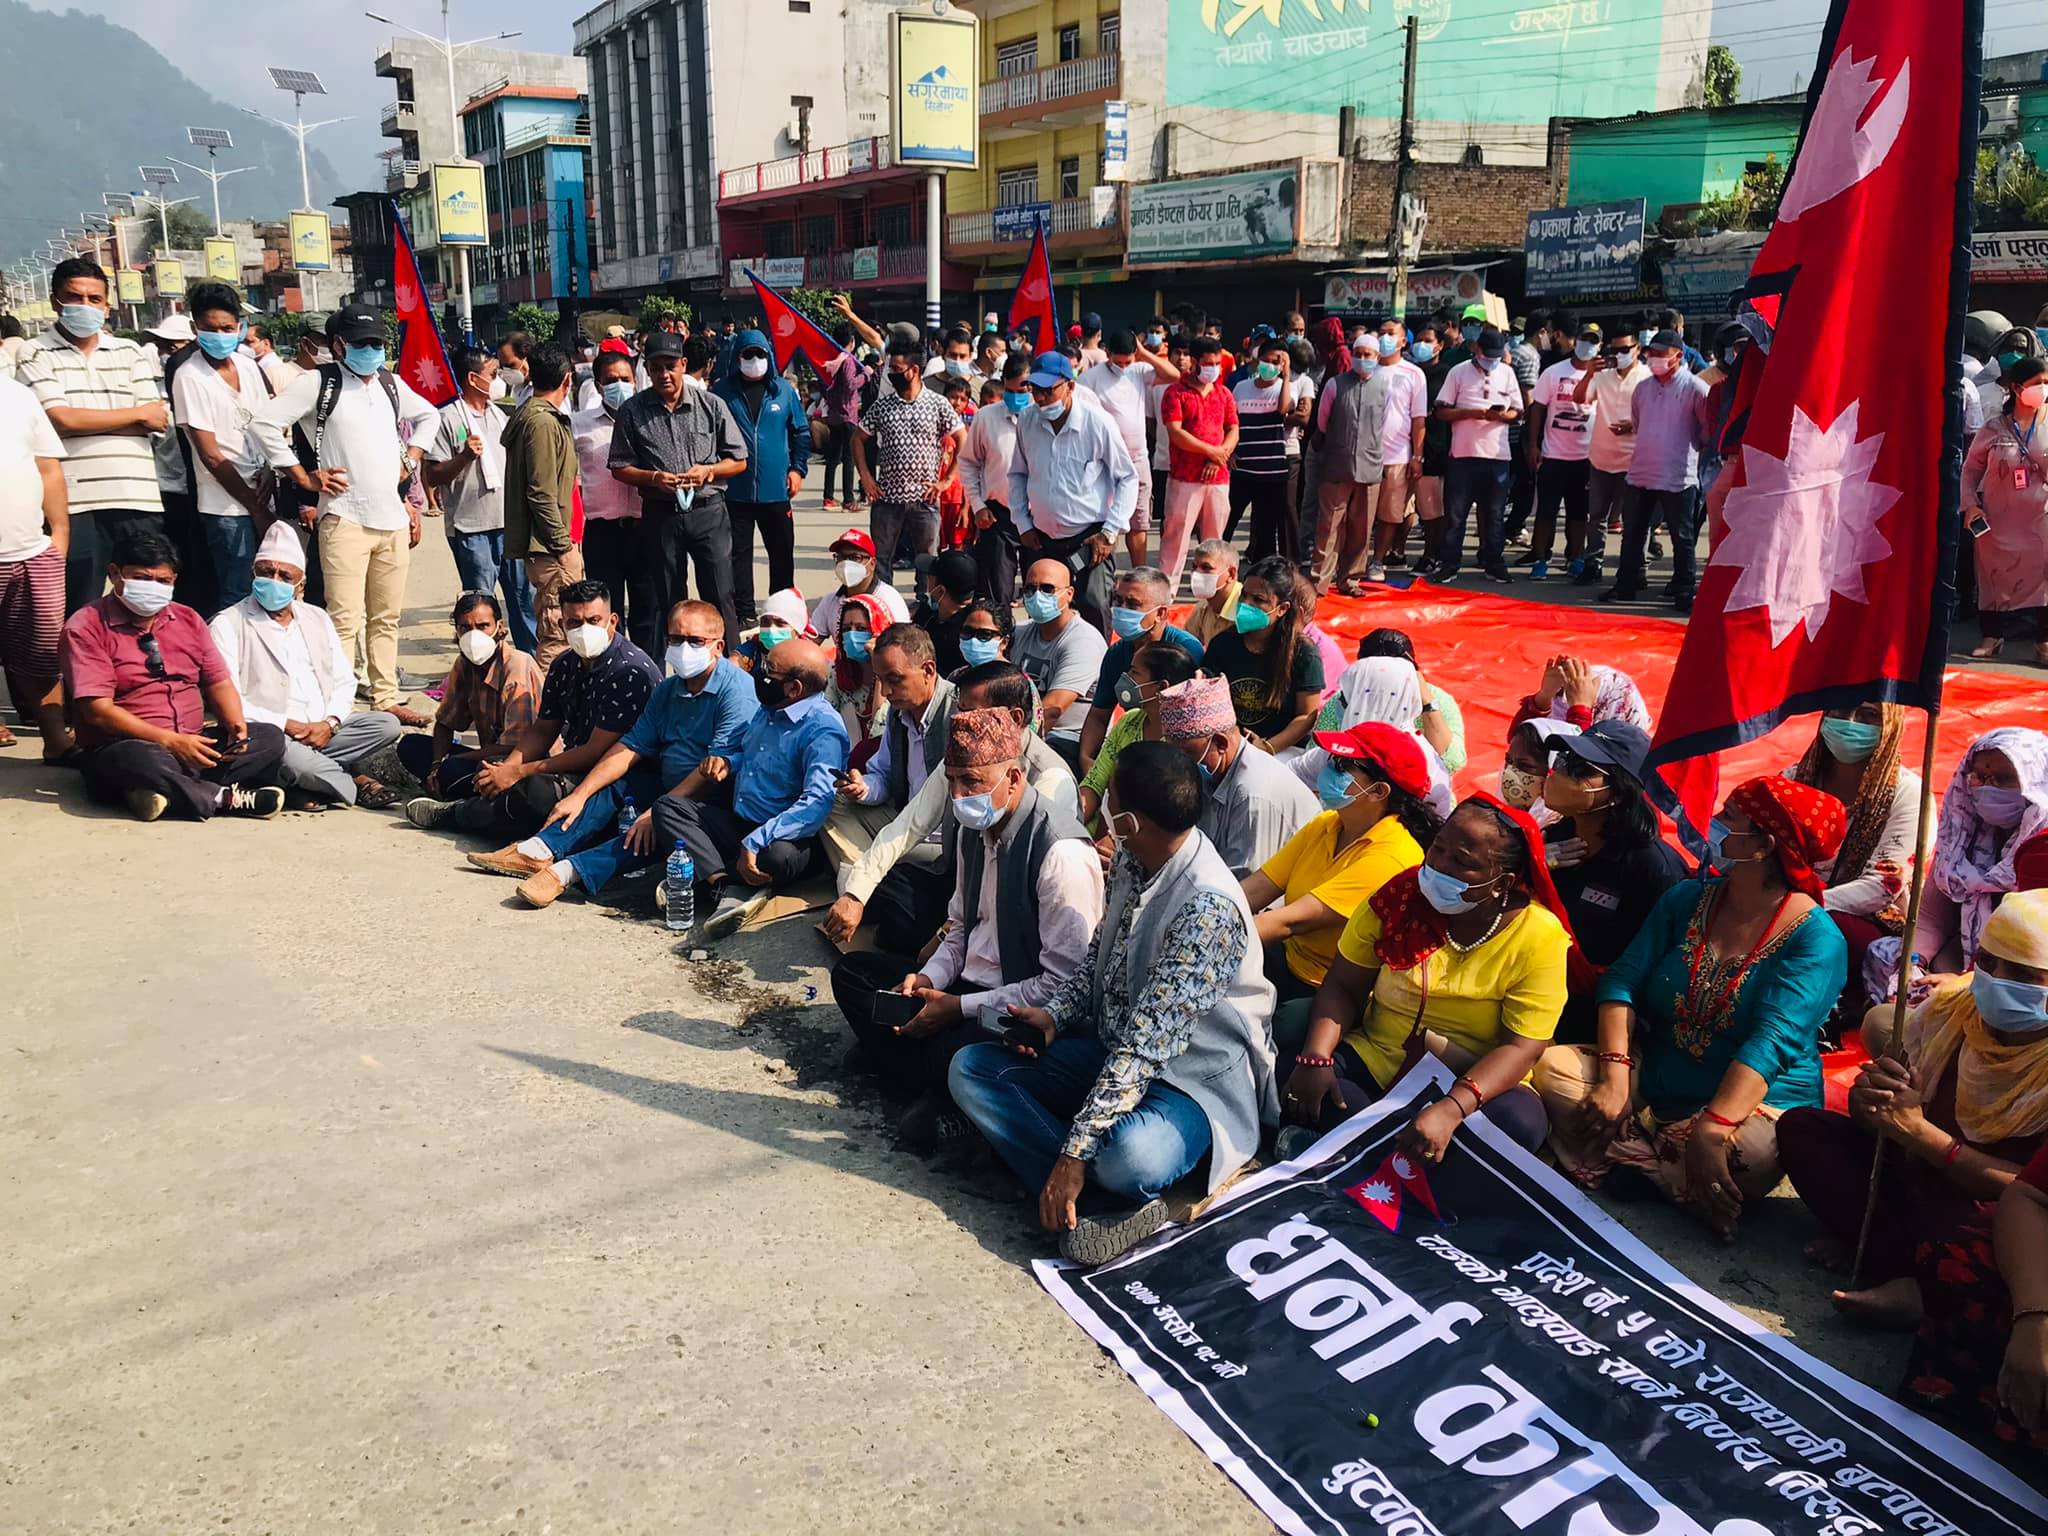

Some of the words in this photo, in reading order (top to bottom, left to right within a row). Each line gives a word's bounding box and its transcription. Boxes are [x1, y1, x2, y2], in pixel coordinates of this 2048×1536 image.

[1215, 32, 1273, 70] तयारी
[1283, 26, 1370, 59] चाउचाउ
[1188, 200, 1214, 222] केयर
[1540, 217, 1572, 241] प्रकाश
[1225, 1212, 1484, 1383] धर्ना
[1152, 1303, 1204, 1347] असोज
[1512, 1250, 1597, 1297] प्रदेश
[1617, 1310, 1656, 1337] ५
[1645, 1329, 1706, 1369] को
[1695, 1364, 1847, 1465] राजधानी
[1829, 1463, 1972, 1536] बुटवल
[1660, 1402, 1782, 1473] निर्णय
